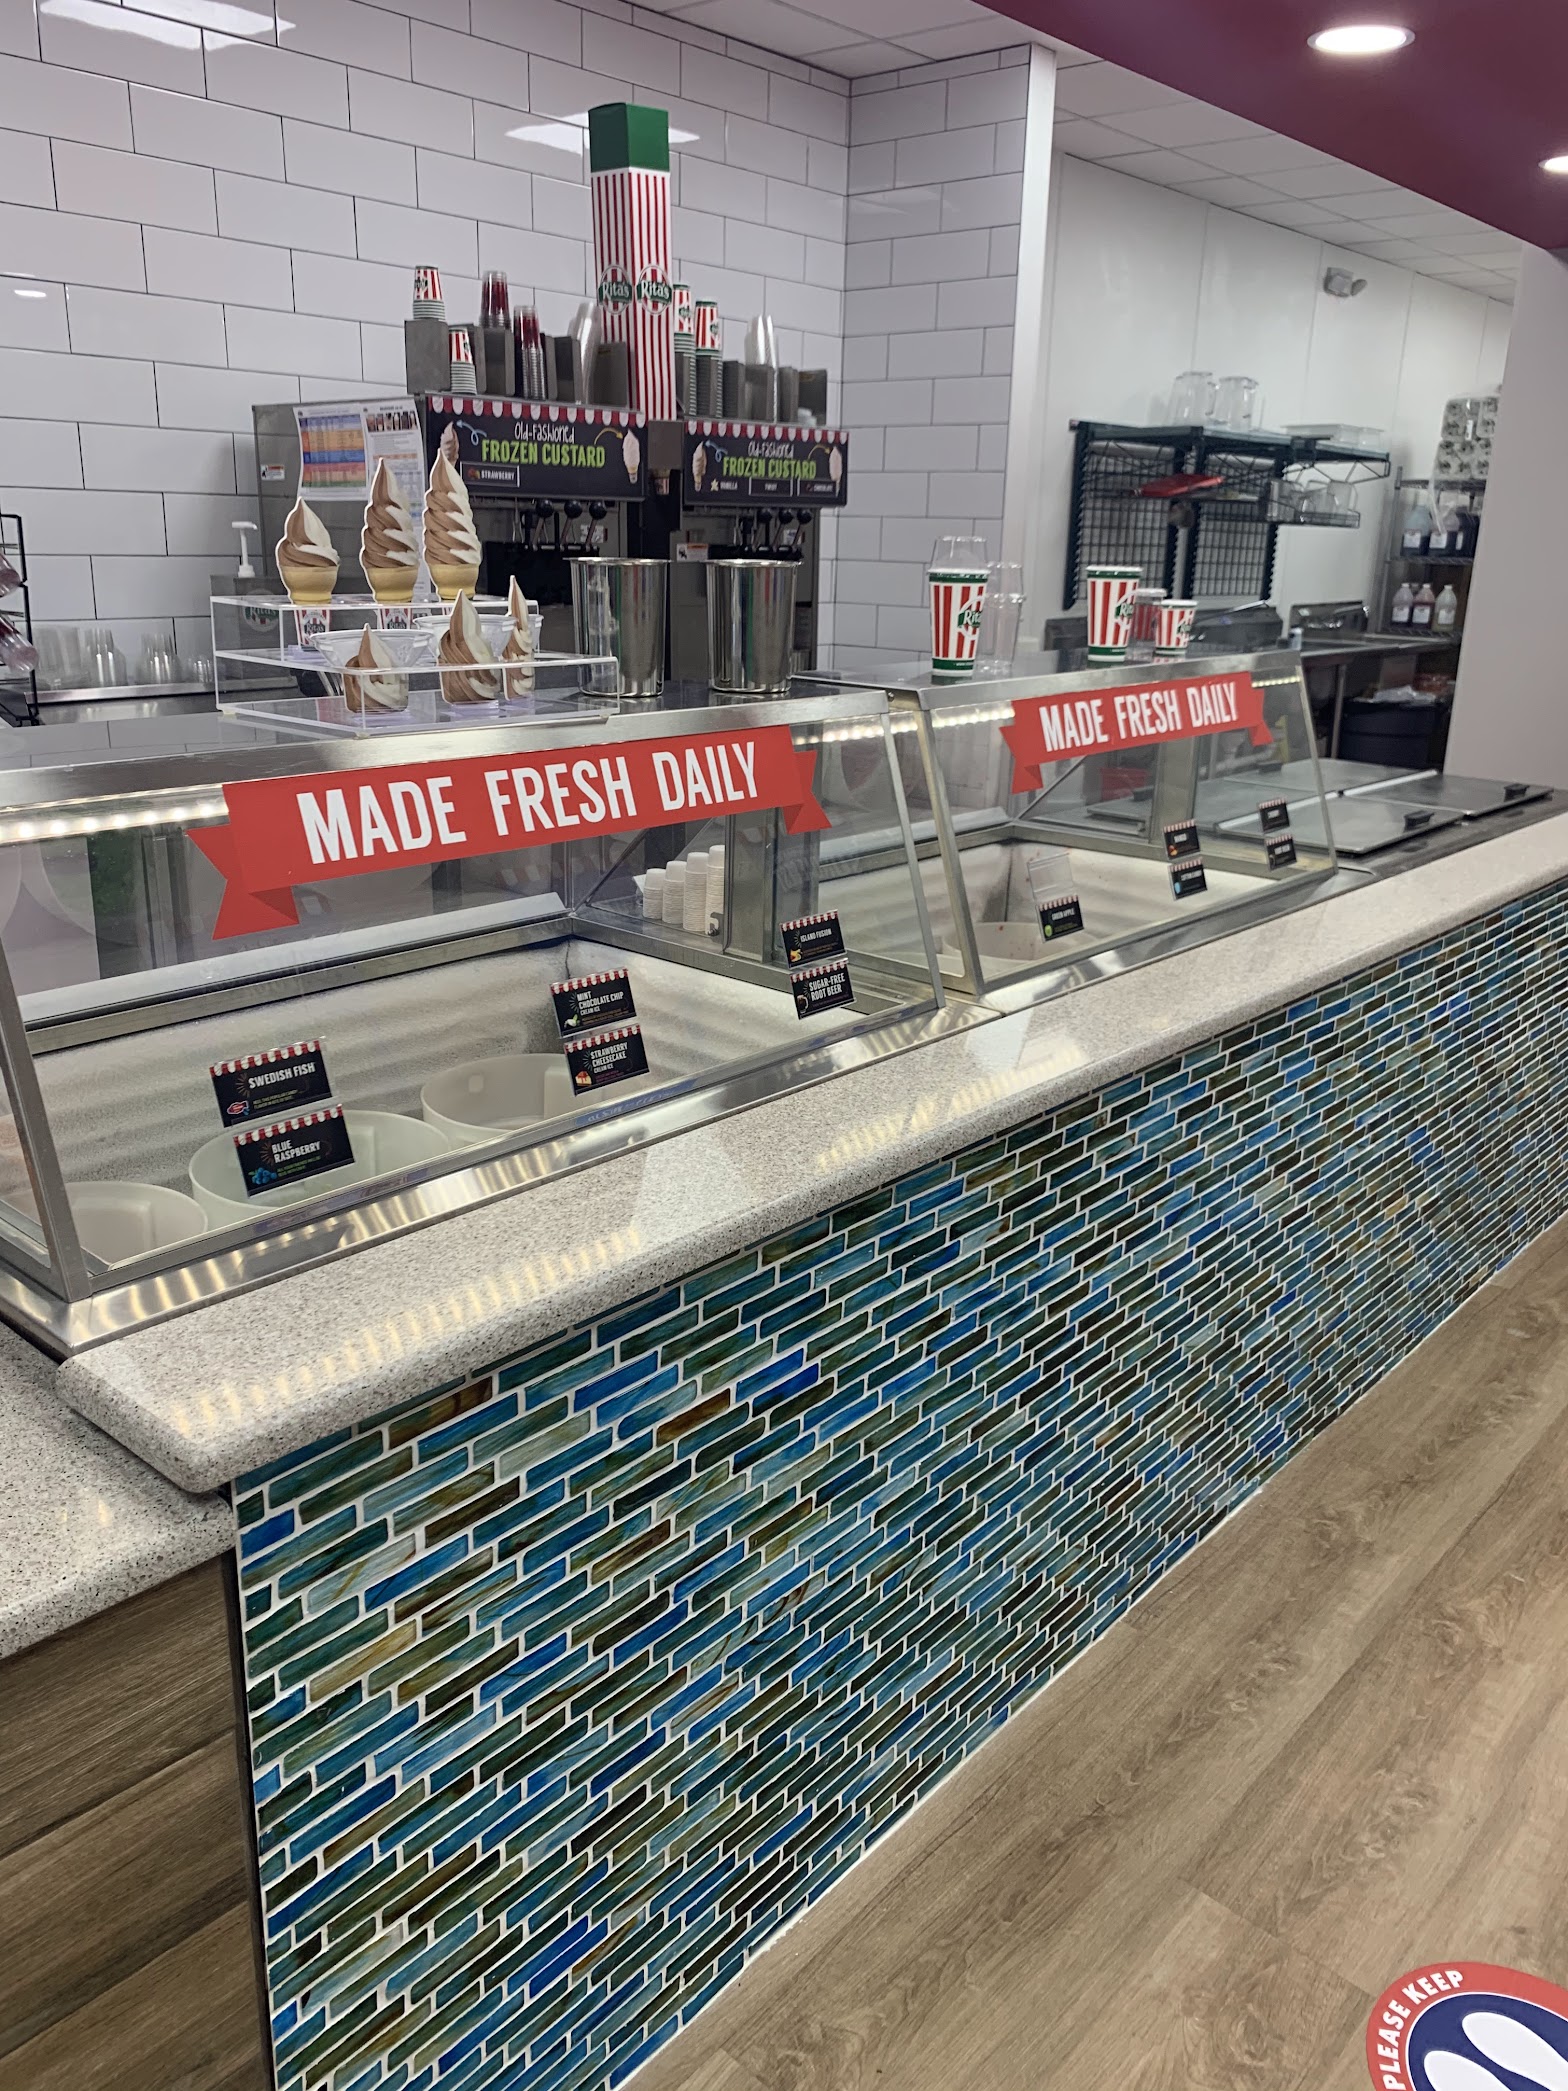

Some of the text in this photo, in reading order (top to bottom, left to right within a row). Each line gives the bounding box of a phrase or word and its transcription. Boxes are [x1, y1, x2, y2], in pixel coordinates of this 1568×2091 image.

[602, 281, 630, 300] Rita's
[641, 280, 670, 300] Rita's
[481, 439, 606, 468] FROZEN CUSTARD
[481, 469, 515, 481] STRAWBERRY
[722, 456, 817, 479] FROZEN CUSTARD
[1038, 682, 1238, 752] MADE FRESH DAILY
[295, 741, 758, 865] MADE FRESH DAILY
[800, 928, 832, 943] ISLAND FUSION
[808, 973, 845, 991] SUGAR-FREE
[577, 991, 592, 1001] MINT
[579, 992, 624, 1009] CHOCOLATE CHIP
[811, 989, 827, 1001] ROOT
[827, 984, 842, 997] BEER
[590, 1042, 628, 1059] STRAWBERRY
[592, 1050, 627, 1068] CHEESECAKE
[248, 1062, 316, 1089] SWEDISH FISH
[271, 1140, 293, 1154] BLUE
[273, 1141, 321, 1163] RASPBERRY
[1377, 1970, 1464, 2091] PLEASE KEEP
